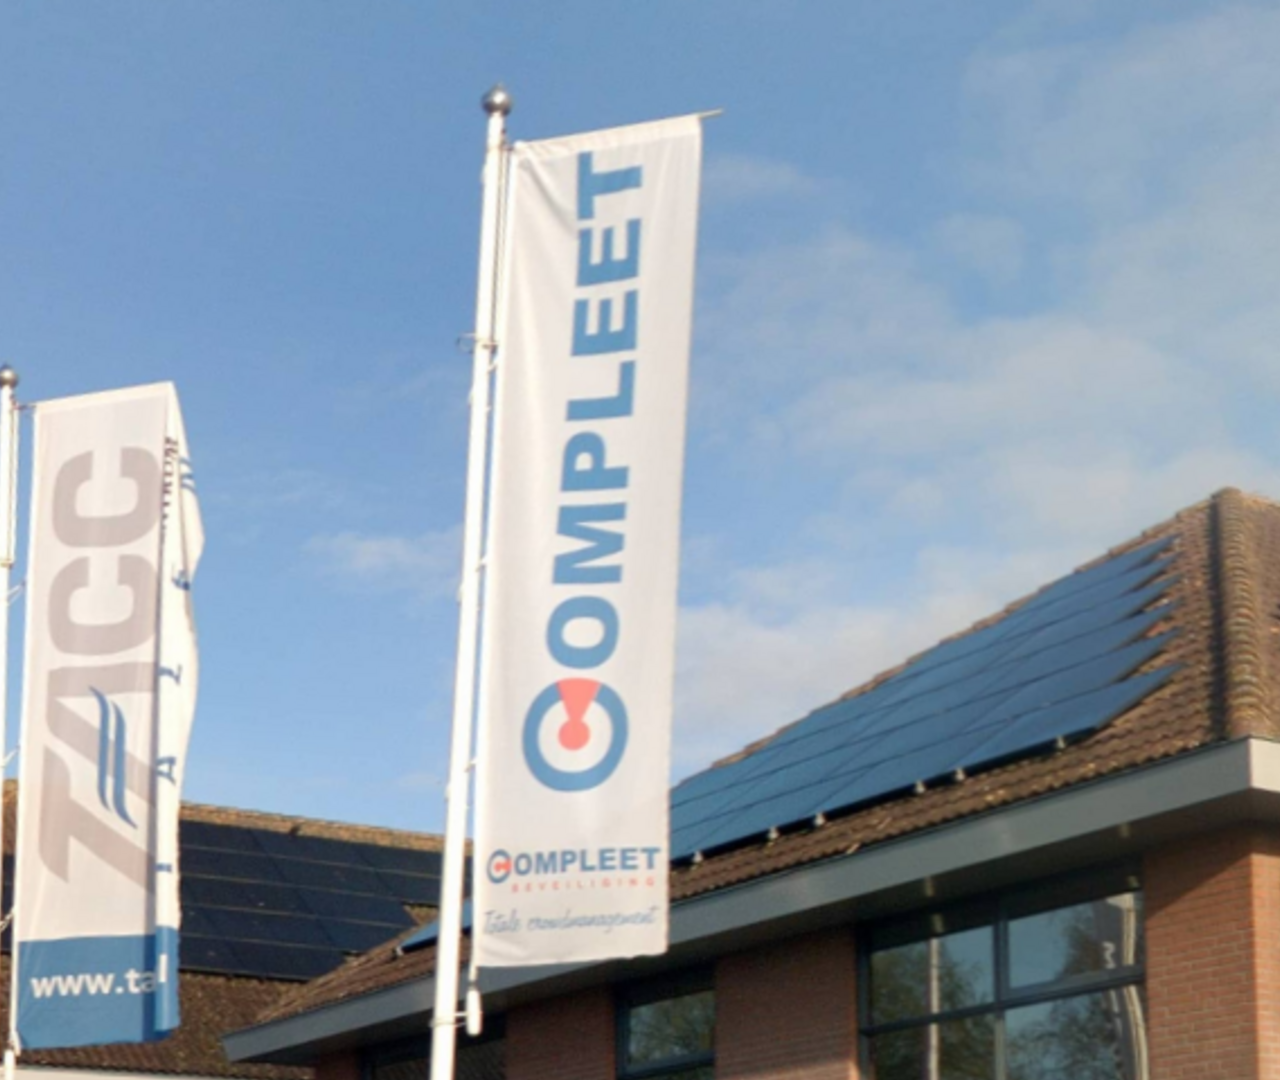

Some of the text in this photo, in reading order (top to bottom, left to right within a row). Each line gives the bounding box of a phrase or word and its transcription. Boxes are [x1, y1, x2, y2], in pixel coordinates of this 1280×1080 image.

[522, 151, 642, 792] COMPLEET
[487, 847, 661, 883] COMPLEET
[511, 877, 656, 893] BEVEILIGING
